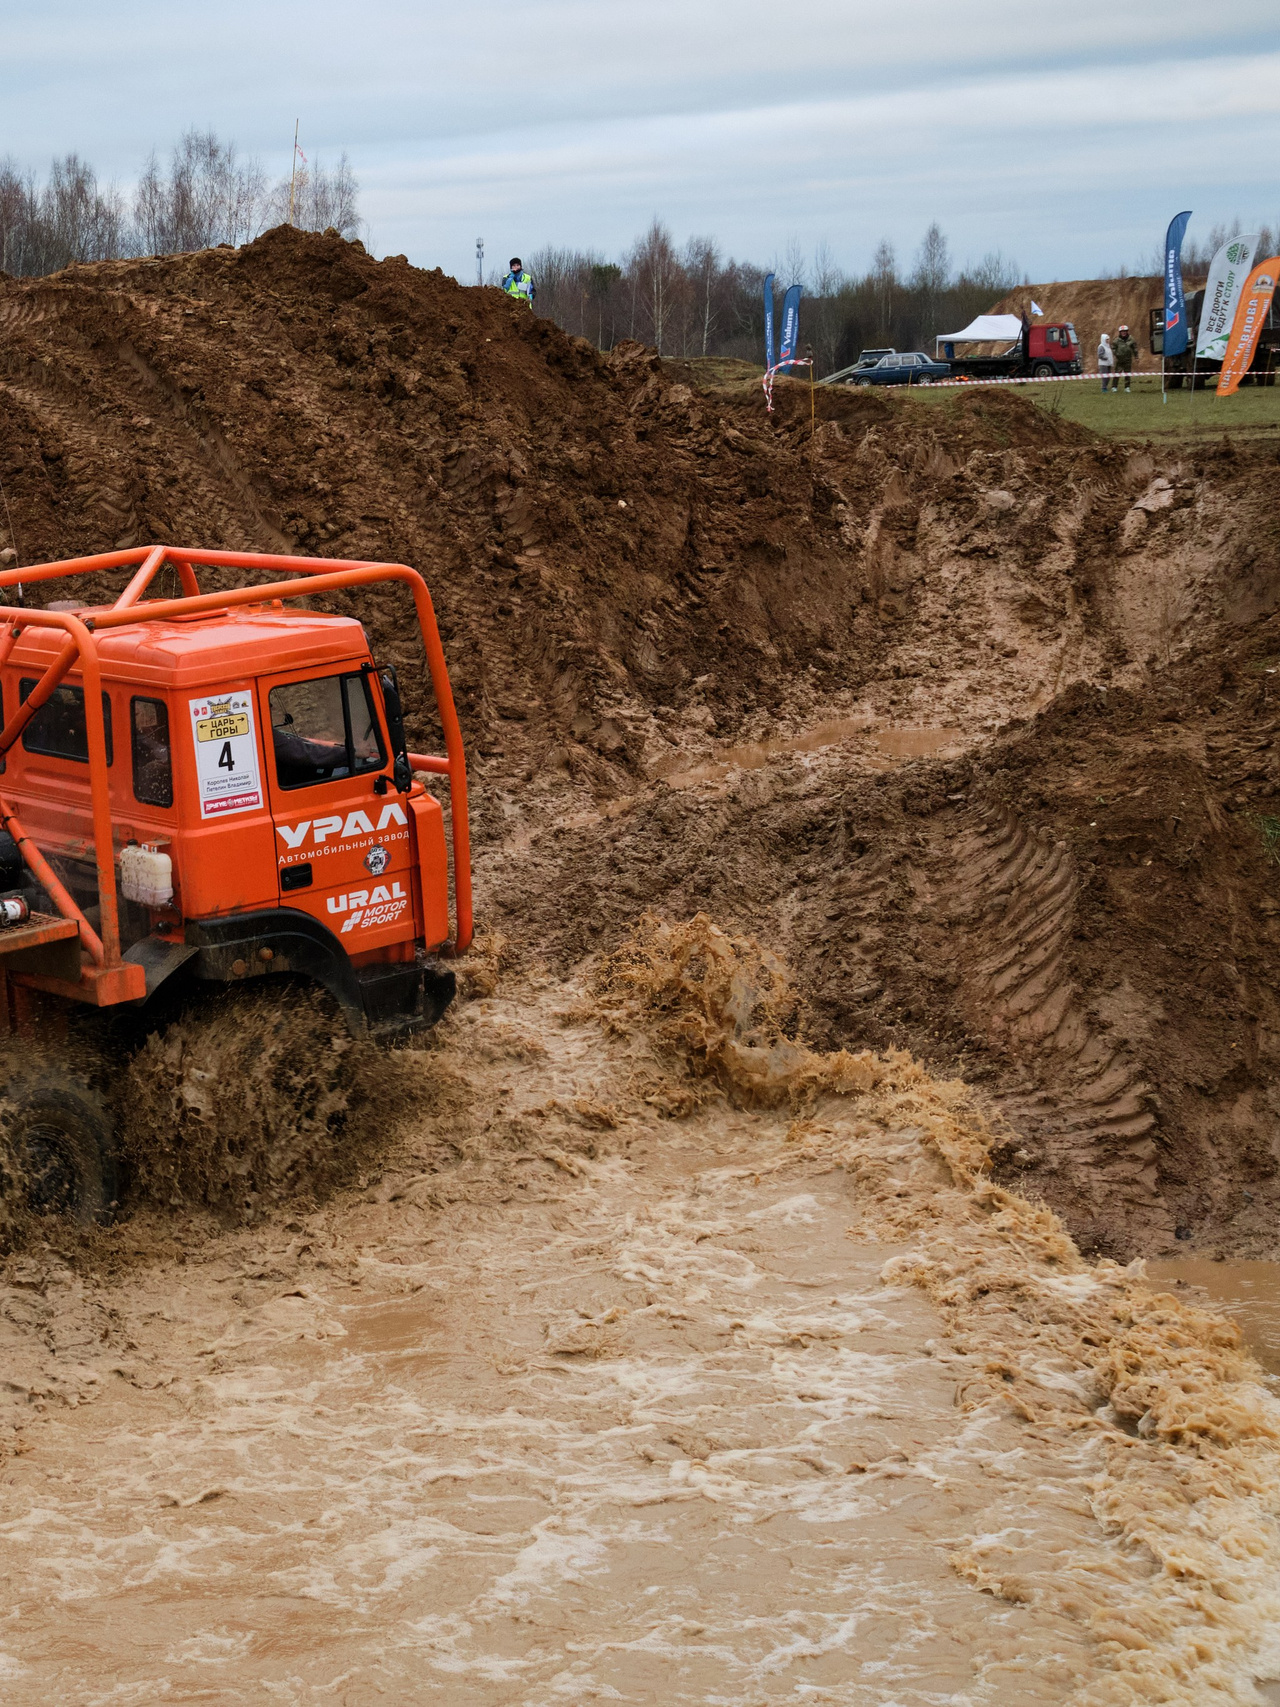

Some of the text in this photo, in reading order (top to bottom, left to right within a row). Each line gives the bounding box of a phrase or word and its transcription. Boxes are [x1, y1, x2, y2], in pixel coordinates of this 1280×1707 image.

[1168, 249, 1177, 309] Volume
[1206, 281, 1225, 332] ВСЕ ДОРОГИ
[1215, 306, 1227, 333] ВЕДУТ
[1224, 270, 1235, 298] СТОЛУ
[783, 307, 794, 345] Volume
[210, 726, 238, 738] ГОРЫ
[211, 718, 235, 729] ЦАРЬ
[218, 741, 236, 771] 4
[276, 802, 408, 849] УРАЛ
[278, 830, 410, 865] Автомобильный завод
[326, 881, 407, 914] URAL
[363, 900, 407, 919] MOTOR
[360, 910, 402, 928] SPORT
